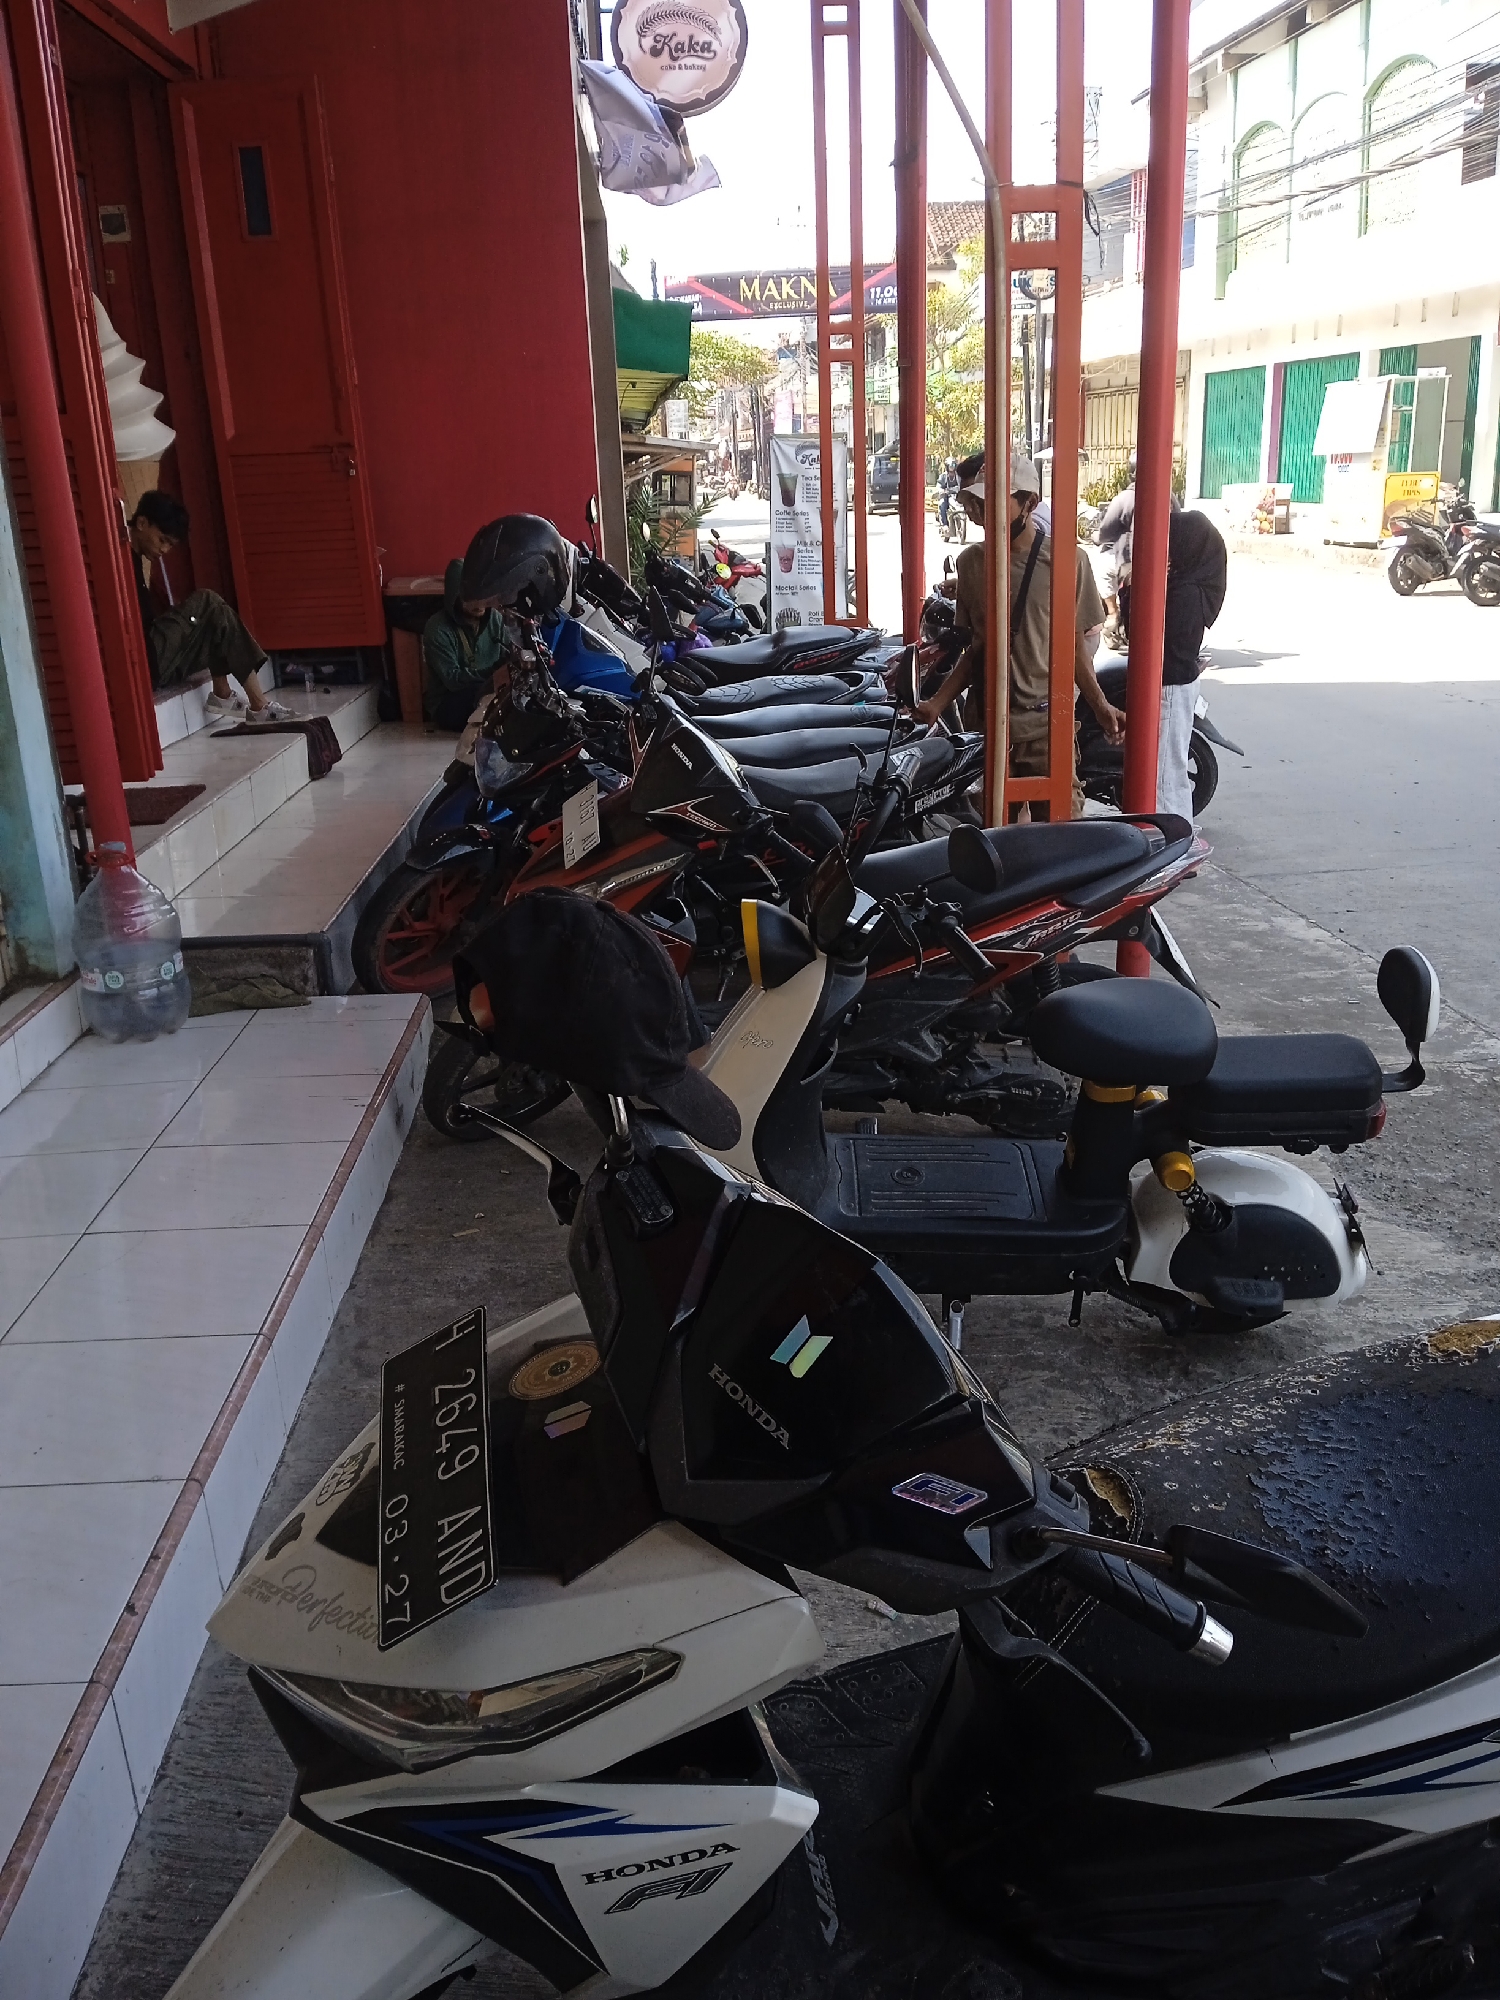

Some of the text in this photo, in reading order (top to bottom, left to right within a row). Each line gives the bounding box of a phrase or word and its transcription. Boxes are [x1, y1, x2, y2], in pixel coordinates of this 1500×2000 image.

[650, 32, 716, 61] Kaka
[769, 300, 809, 310] EXCLUSIVE
[671, 742, 693, 770] HONDA
[686, 812, 717, 828] TECHNO
[435, 1368, 481, 1480] 2649
[708, 1363, 790, 1450] HONDA
[437, 1505, 486, 1605] AND
[581, 1842, 741, 1886] HONDA
